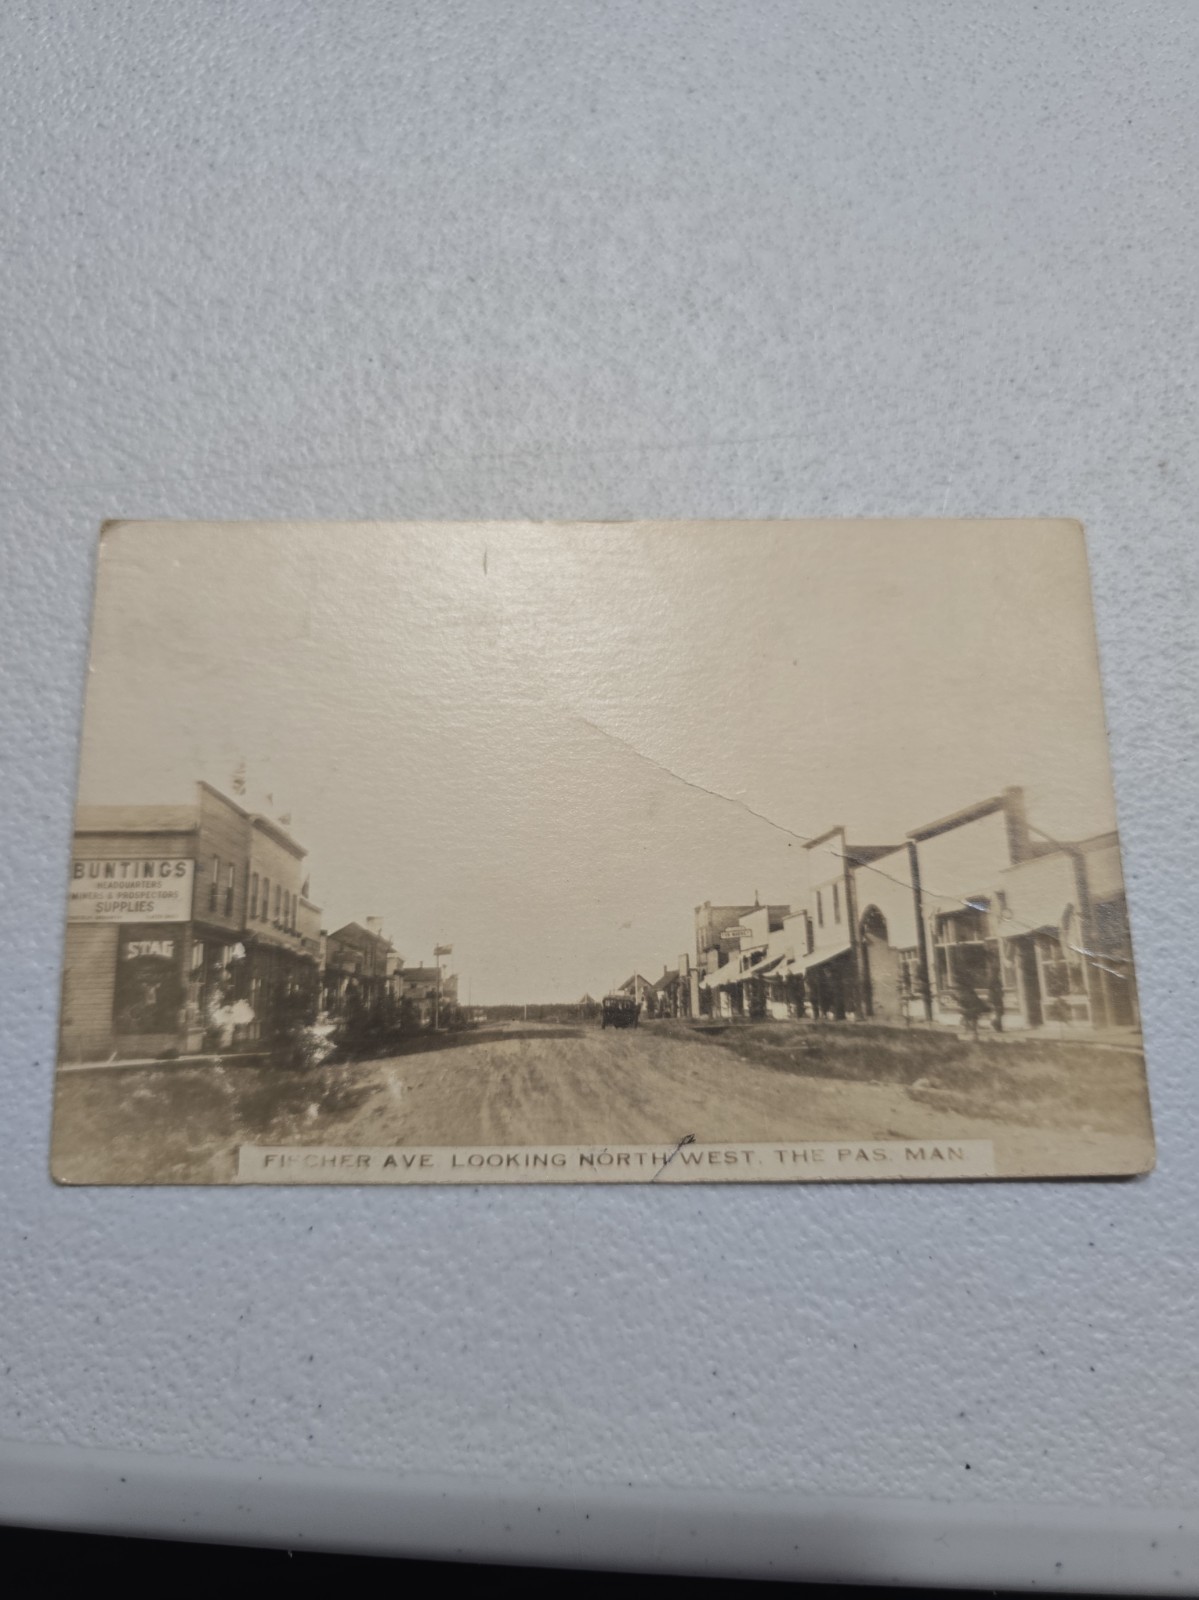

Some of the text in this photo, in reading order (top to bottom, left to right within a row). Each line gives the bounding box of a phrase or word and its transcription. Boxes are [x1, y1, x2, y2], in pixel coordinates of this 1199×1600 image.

[73, 861, 187, 879] BUNTINGS
[97, 881, 162, 889] HEADQUARTERS
[117, 891, 179, 900] PROSPECTORS
[95, 901, 155, 912] SUPPLIES
[383, 1153, 434, 1168] AVE
[451, 1152, 567, 1168] LOOKING
[579, 1149, 668, 1167] NORTH
[777, 1149, 824, 1163] THE
